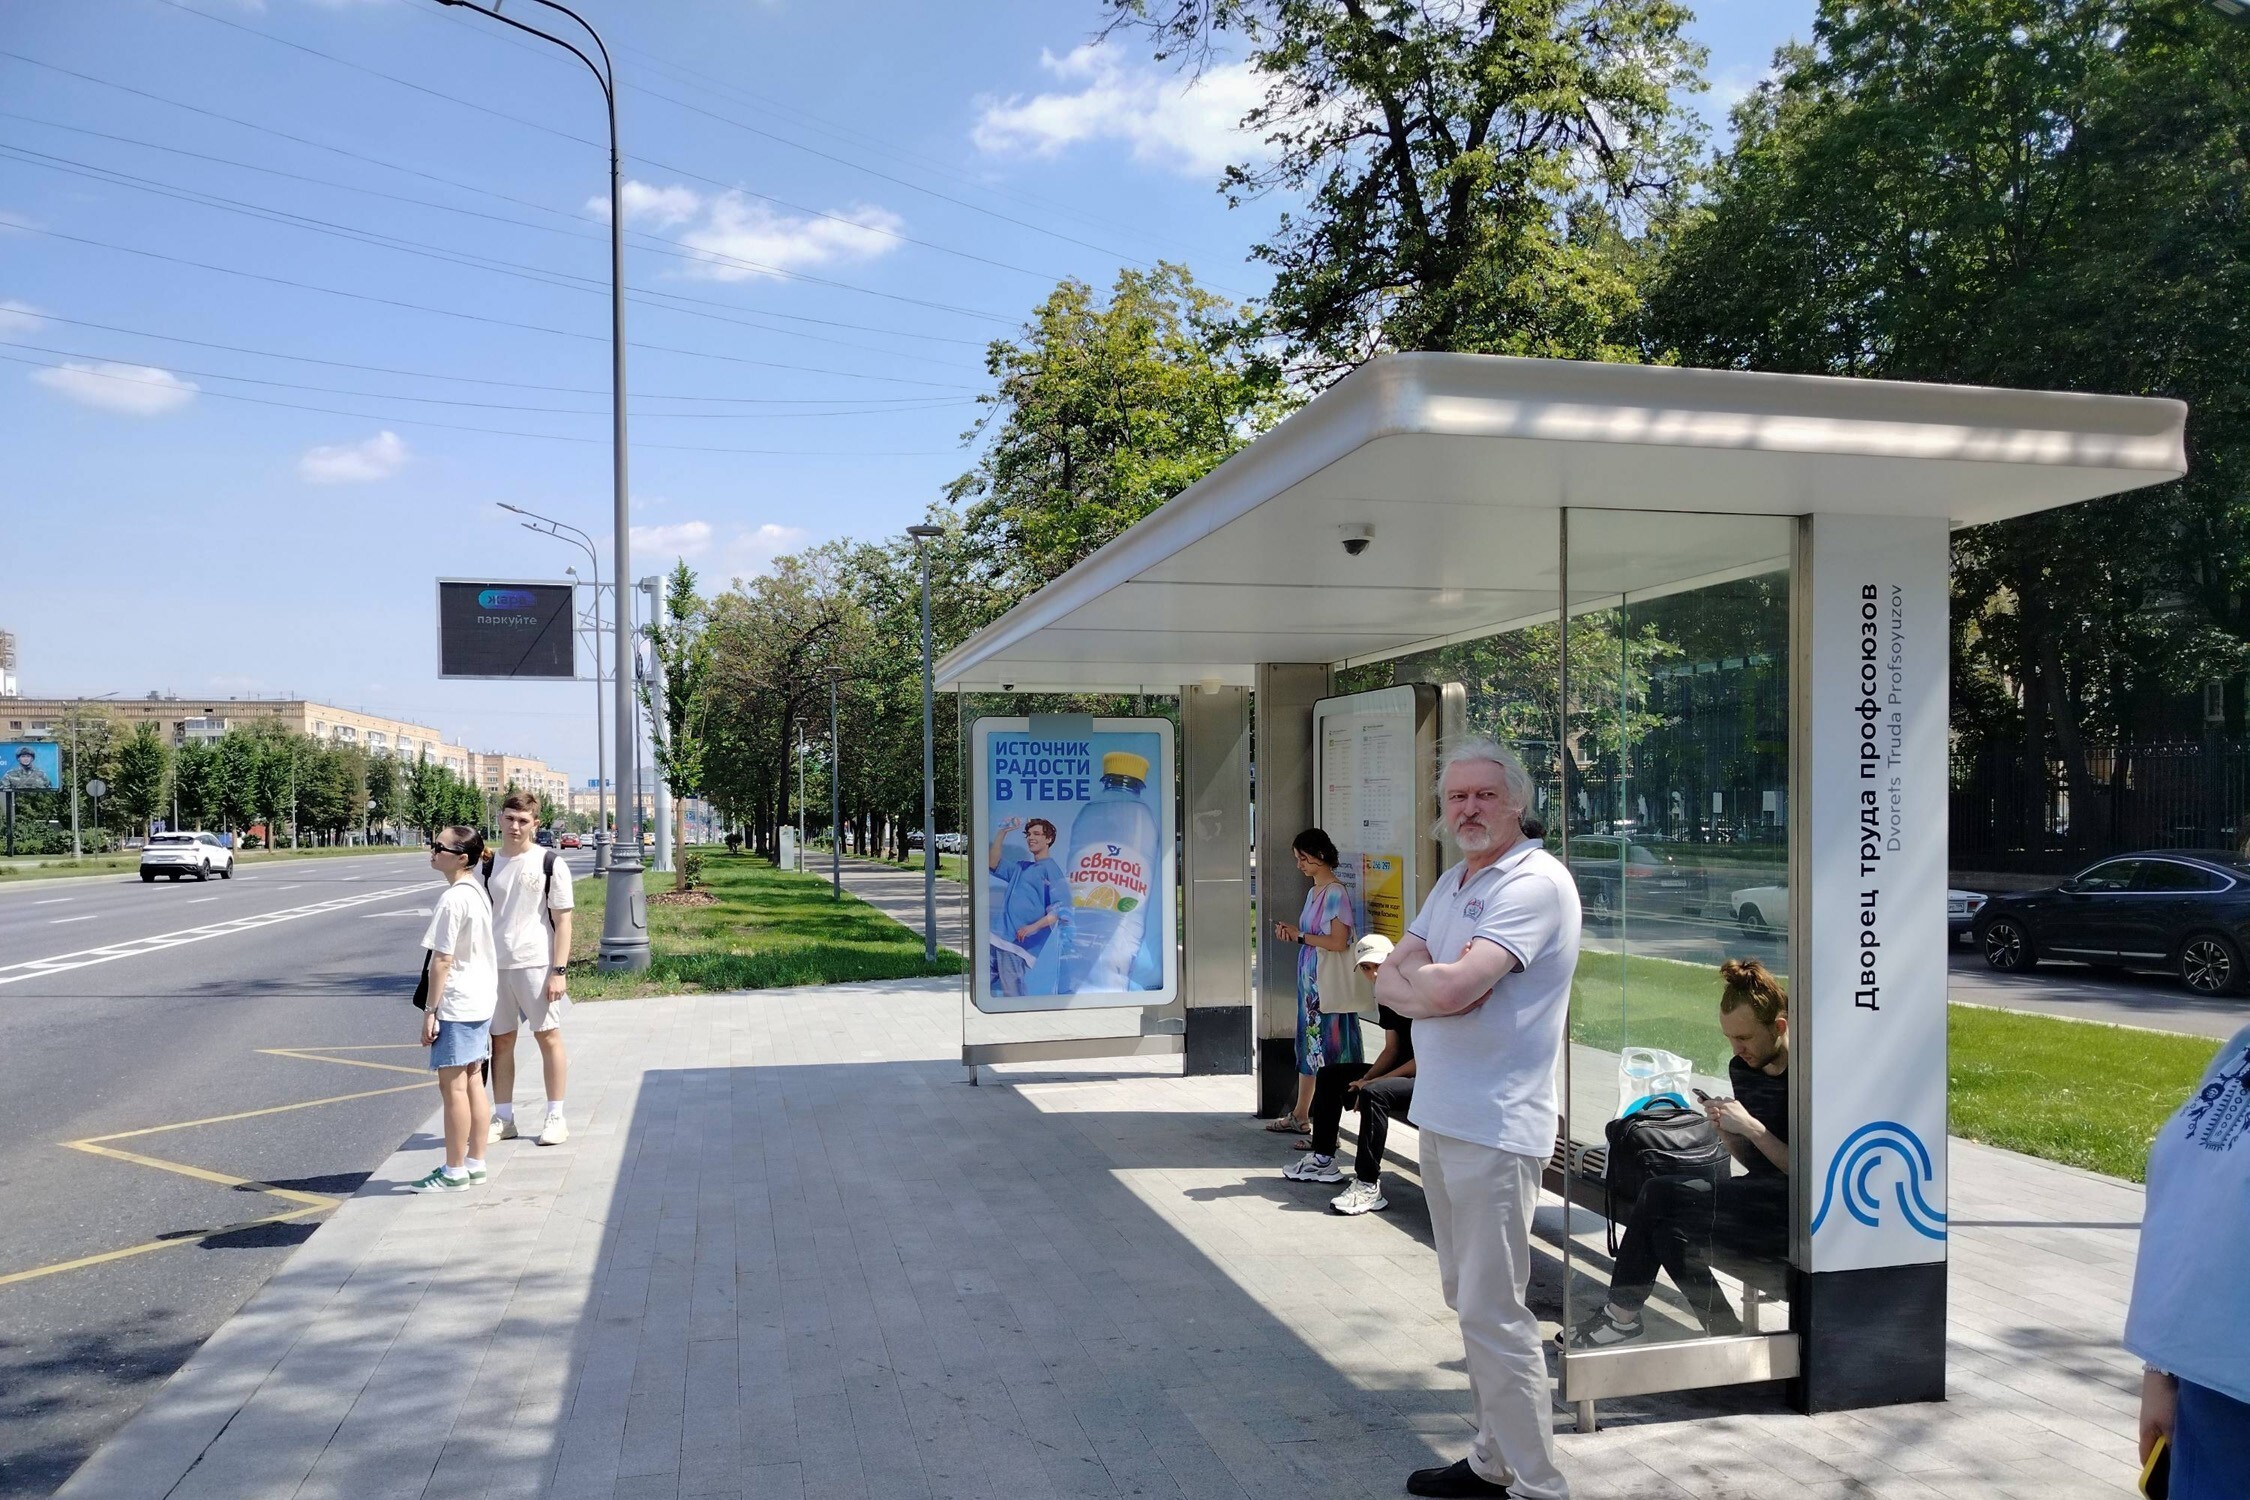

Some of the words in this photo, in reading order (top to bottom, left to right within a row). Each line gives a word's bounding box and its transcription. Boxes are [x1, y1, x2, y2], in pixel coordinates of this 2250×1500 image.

[477, 614, 538, 627] паркуйте
[1888, 585, 1905, 704] Profsoyuzov
[1855, 584, 1881, 778] профсоюзов
[996, 741, 1090, 756] ИСТОЧНИК
[996, 759, 1090, 778] РАДОСТИ
[1888, 712, 1902, 768] Truda
[996, 779, 1013, 801] В
[1020, 779, 1091, 801] ТЕБЕ
[1887, 777, 1902, 851] Dvorets
[1861, 790, 1881, 877] труда
[1855, 889, 1880, 1011] Дворец
